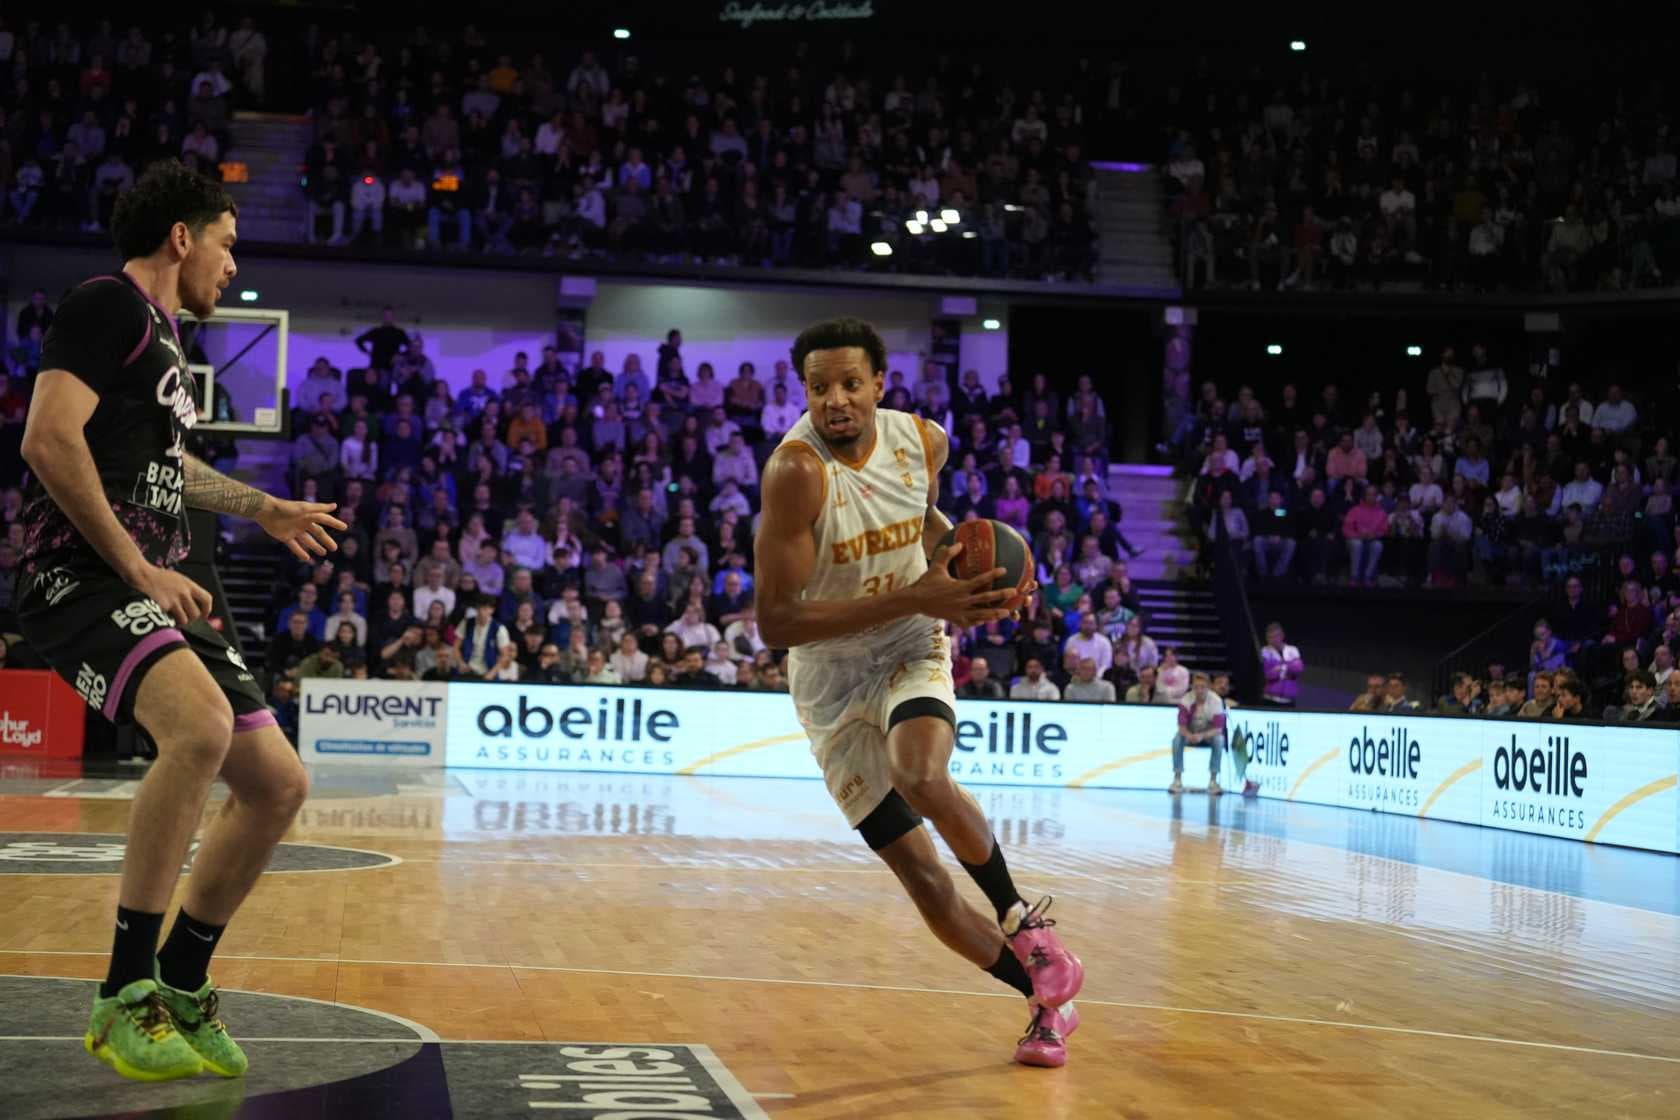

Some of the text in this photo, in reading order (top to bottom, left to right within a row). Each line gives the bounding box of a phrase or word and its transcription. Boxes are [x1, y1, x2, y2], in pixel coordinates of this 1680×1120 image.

[832, 516, 922, 564] EVREUX
[863, 571, 894, 597] 31
[476, 695, 680, 742] abeille
[476, 746, 674, 765] ASSURANCES
[1349, 725, 1421, 779] abeille
[1493, 733, 1588, 797] abeille
[1348, 783, 1419, 807] ASSURANCES
[1493, 799, 1585, 830] ASSURANCES
